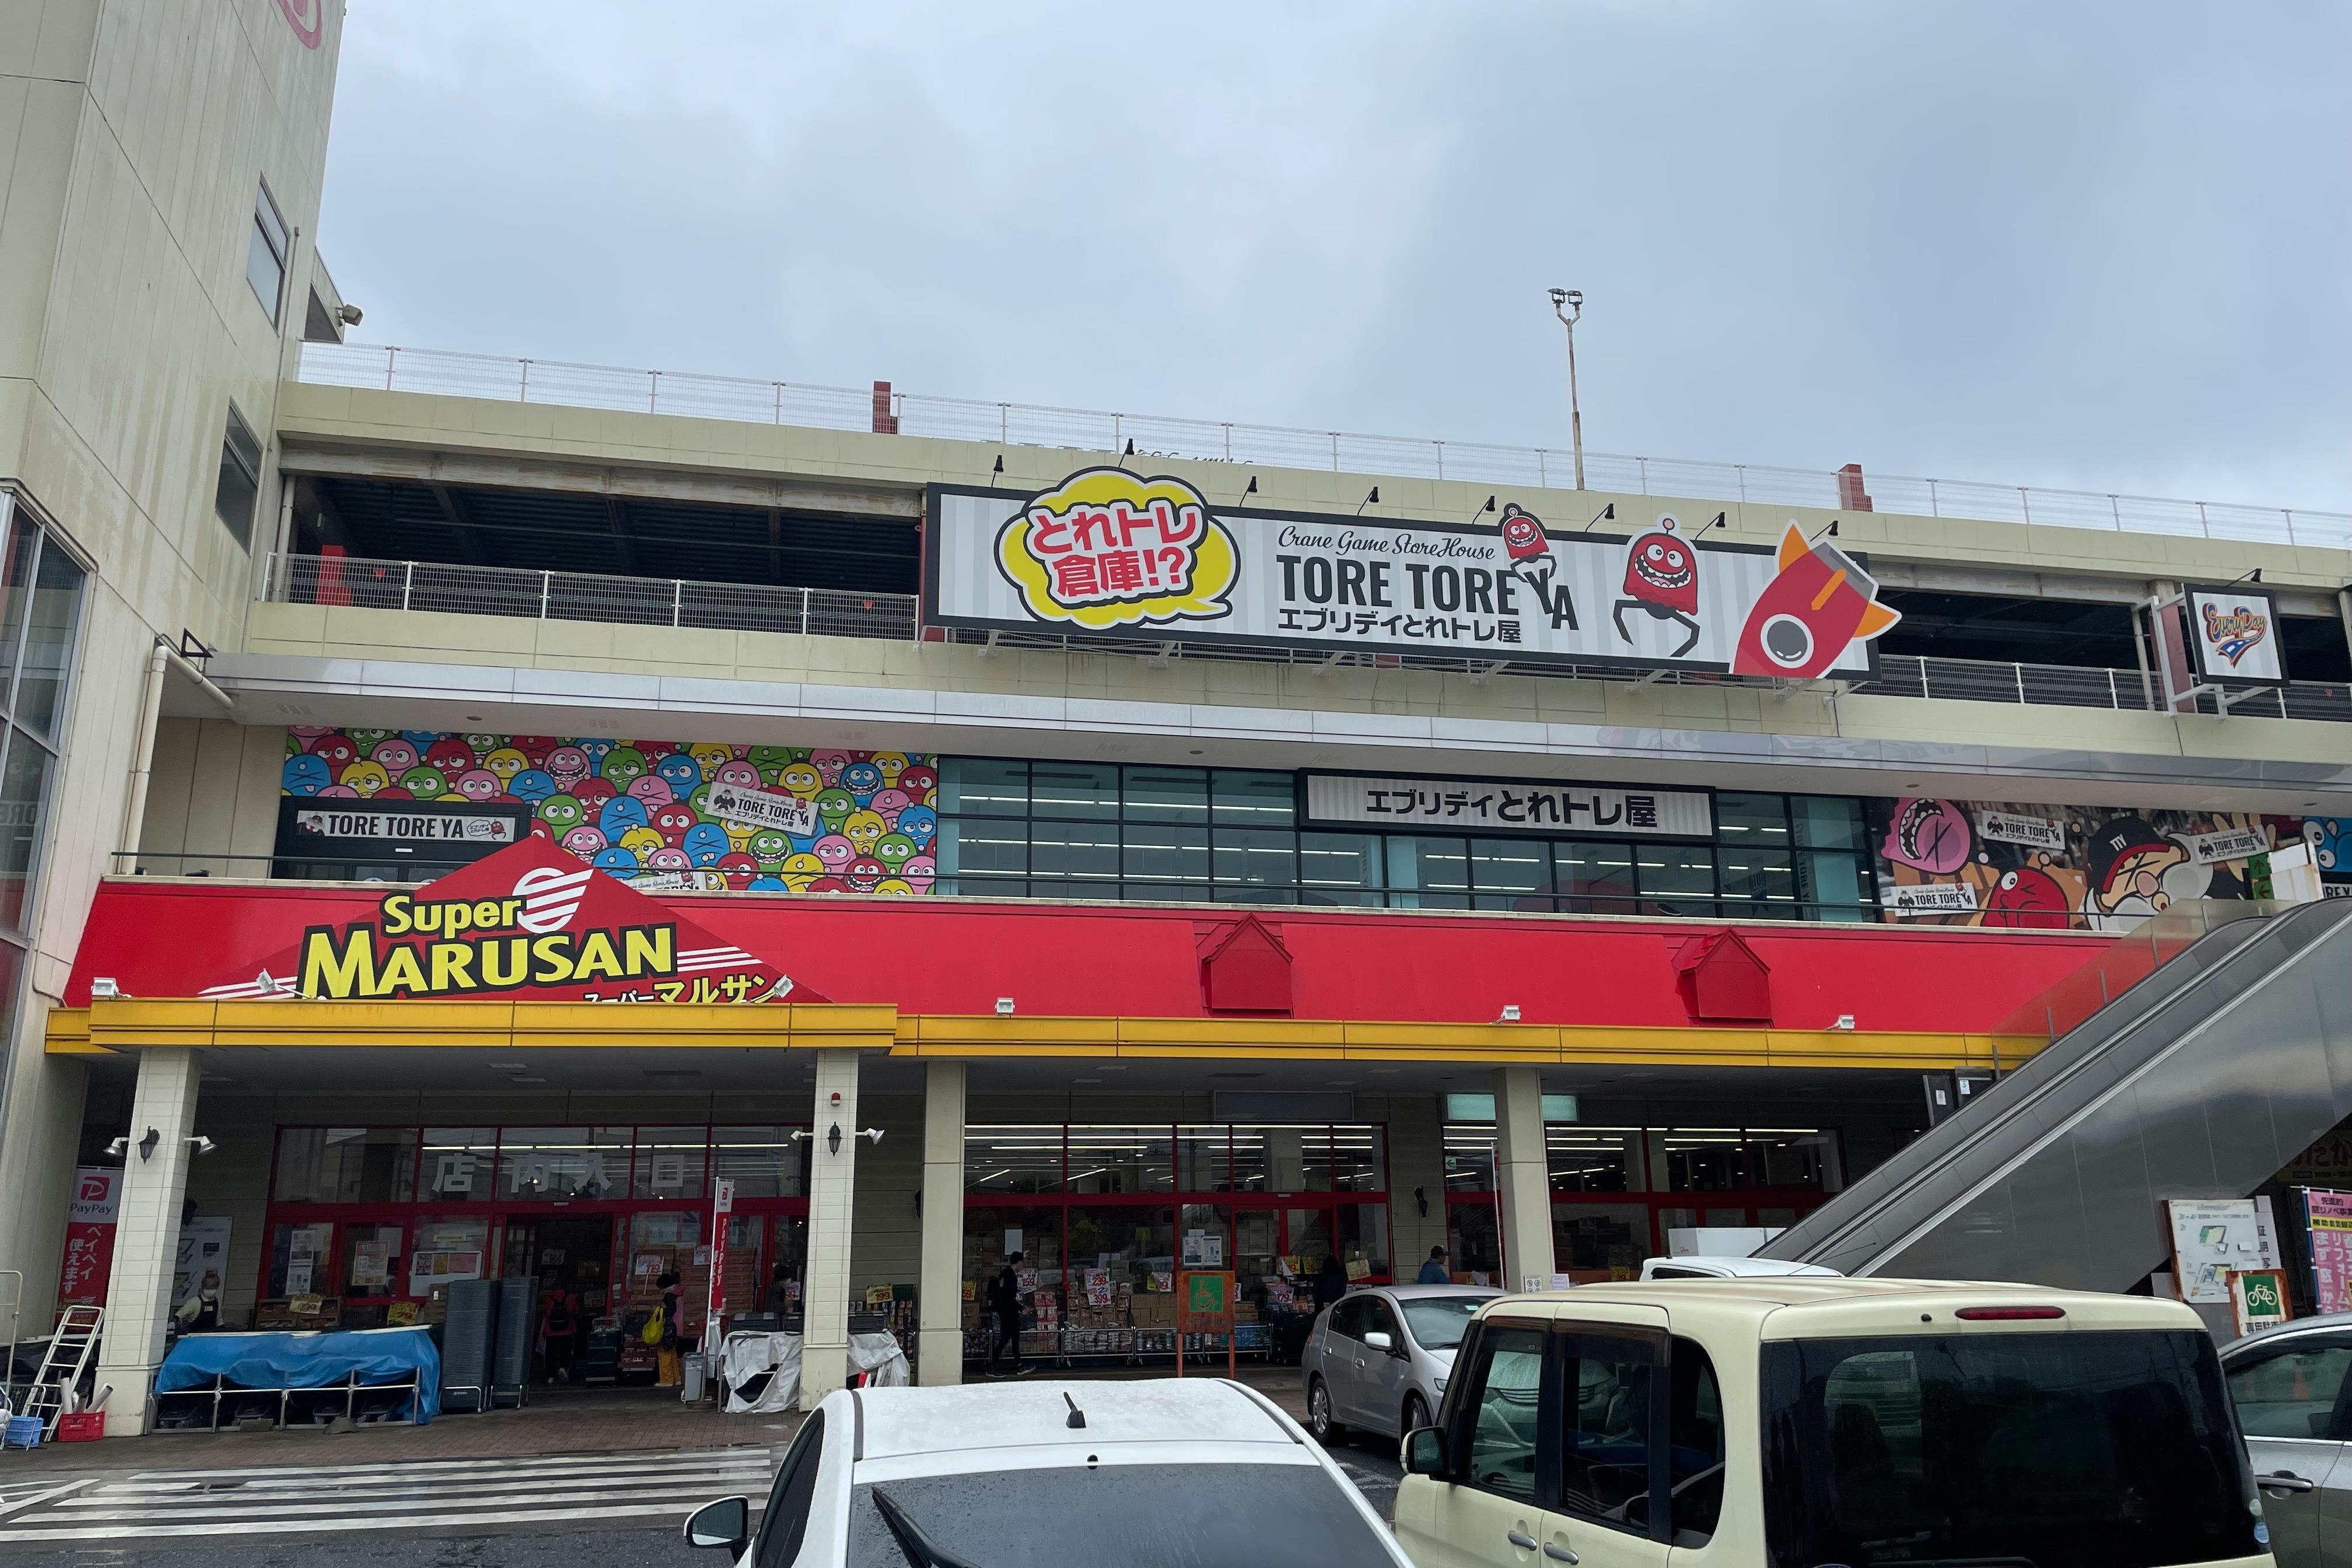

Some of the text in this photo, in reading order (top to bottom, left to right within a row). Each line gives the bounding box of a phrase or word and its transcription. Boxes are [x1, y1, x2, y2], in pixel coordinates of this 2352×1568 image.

[1034, 506, 1196, 554] とれトレ
[1278, 525, 1333, 548] Crane
[1335, 530, 1389, 555] Game
[1052, 546, 1185, 597] 倉庫!?
[1276, 554, 1392, 607] TORE
[1278, 607, 1522, 643] エブリデイとれトレ屋
[738, 798, 766, 815] TORE
[1366, 788, 1658, 828] エブリデイとれトレ屋
[328, 814, 380, 835] TORE
[386, 817, 437, 838] TORE
[2004, 822, 2027, 835] TORE
[2213, 839, 2234, 851] TORE
[384, 895, 523, 939] Super
[1915, 894, 1938, 905] TORE
[303, 927, 672, 999] MARUSAN
[70, 1203, 113, 1216] PayPay
[62, 1238, 86, 1294] 使えます
[80, 1225, 102, 1281] ペイペイ
[1021, 1278, 1035, 1287] 159
